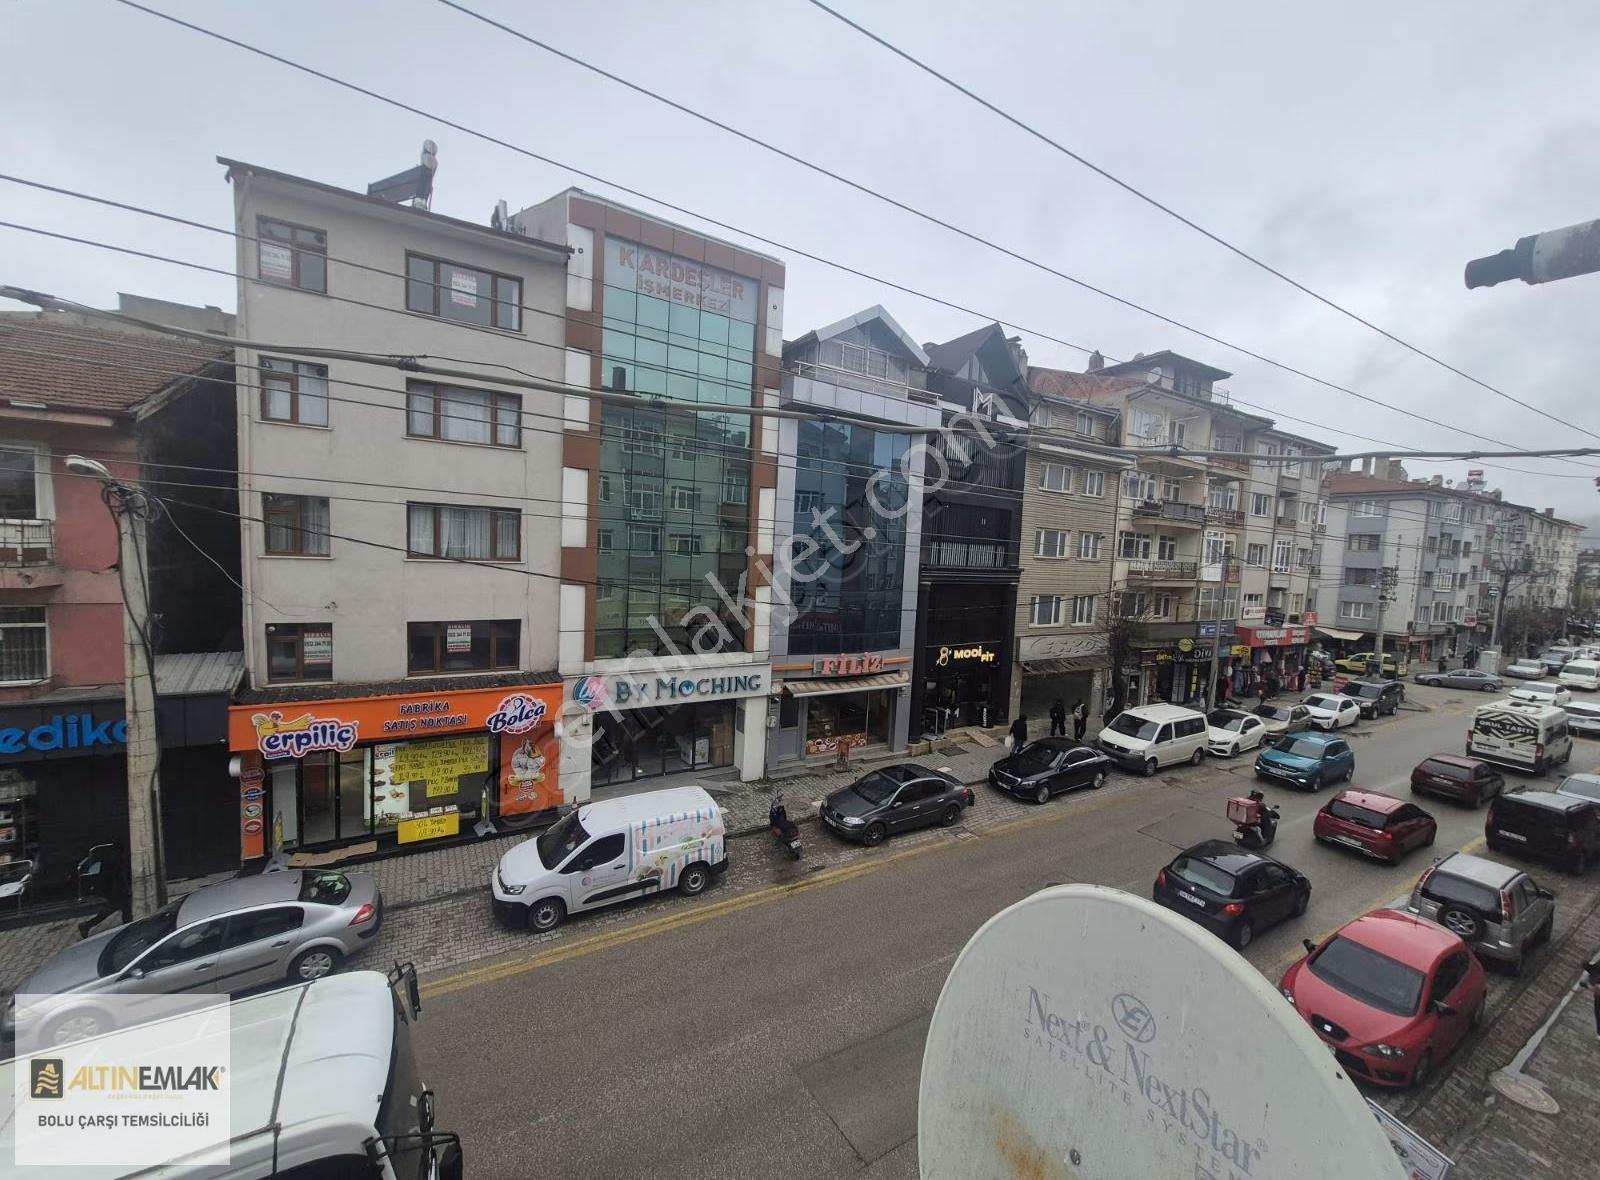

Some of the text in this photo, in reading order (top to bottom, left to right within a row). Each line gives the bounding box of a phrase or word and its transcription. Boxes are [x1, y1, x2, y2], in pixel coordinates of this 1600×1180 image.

[821, 651, 882, 675] FİLİZ
[399, 700, 450, 714] FABRİKA
[487, 702, 546, 732] Bolca
[265, 724, 352, 753] erpiliç
[1025, 985, 1084, 1054] Next
[1086, 1025, 1116, 1076] &
[1024, 1027, 1132, 1106] SATELLITE
